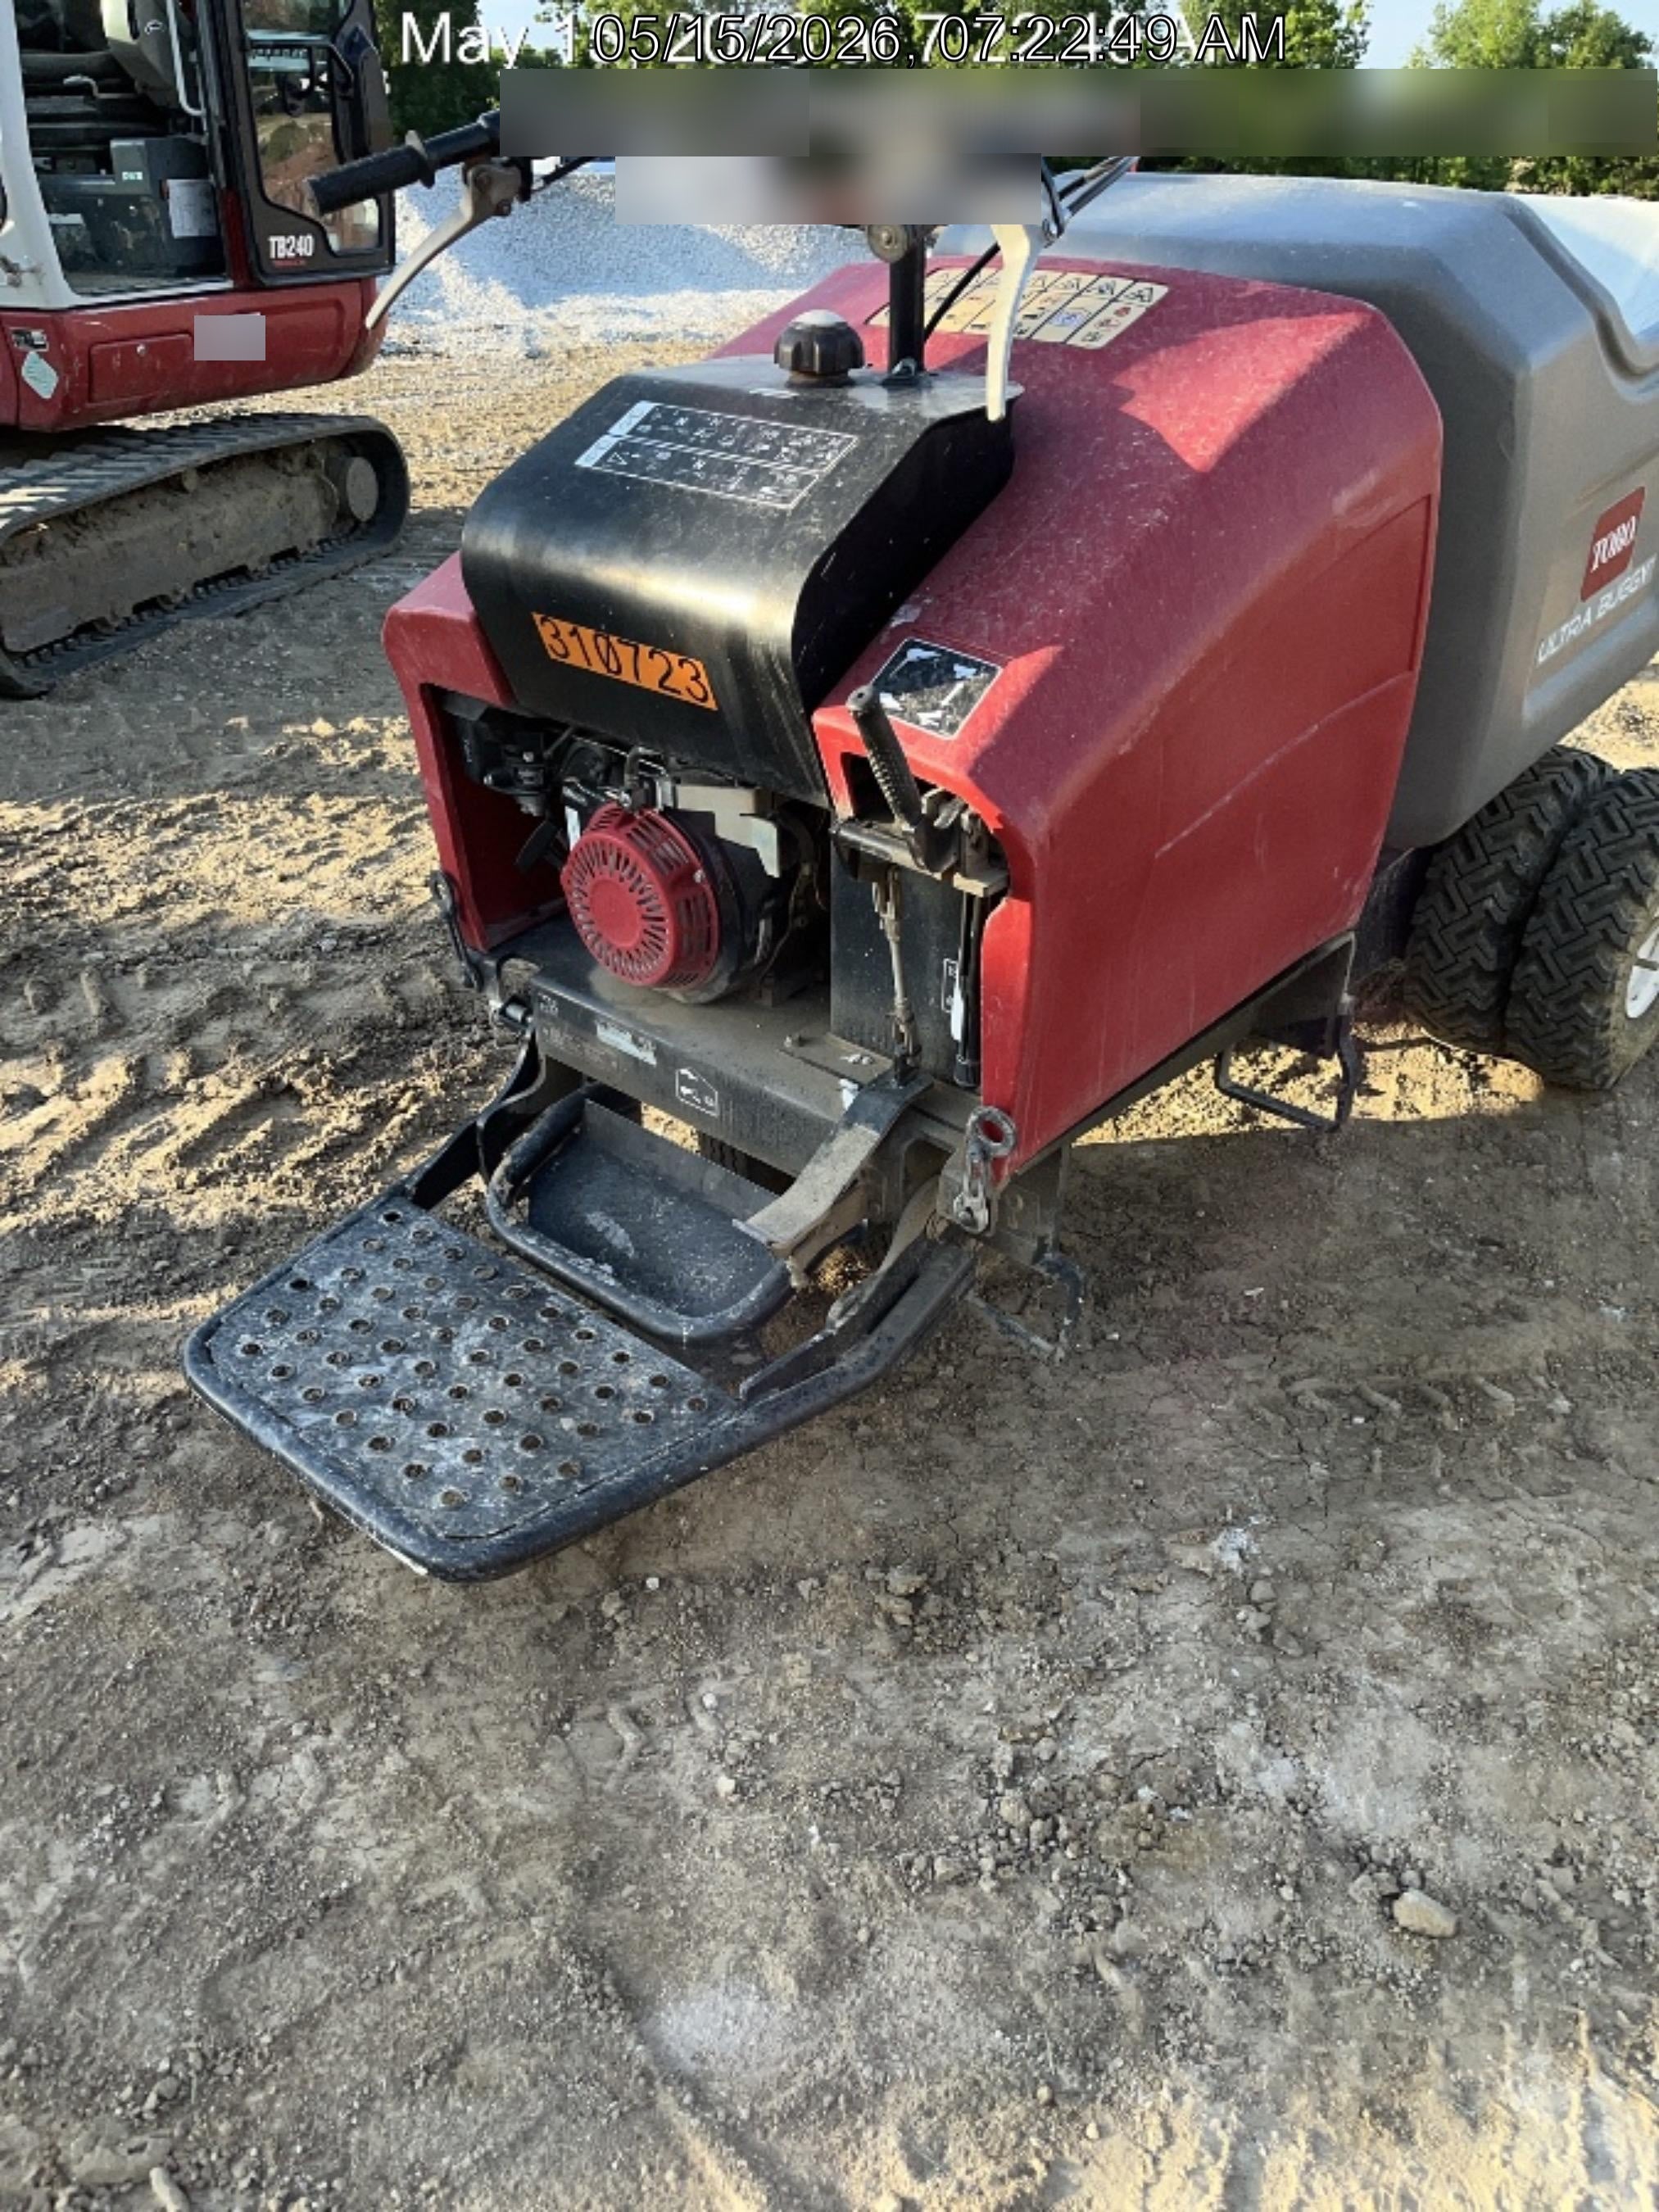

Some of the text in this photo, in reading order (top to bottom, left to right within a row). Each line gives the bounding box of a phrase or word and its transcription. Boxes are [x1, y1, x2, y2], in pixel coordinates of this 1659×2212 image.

[267, 233, 315, 259] TB240
[1590, 515, 1636, 573] TORO
[539, 614, 709, 703] 310723
[1537, 607, 1592, 664] ULTRA
